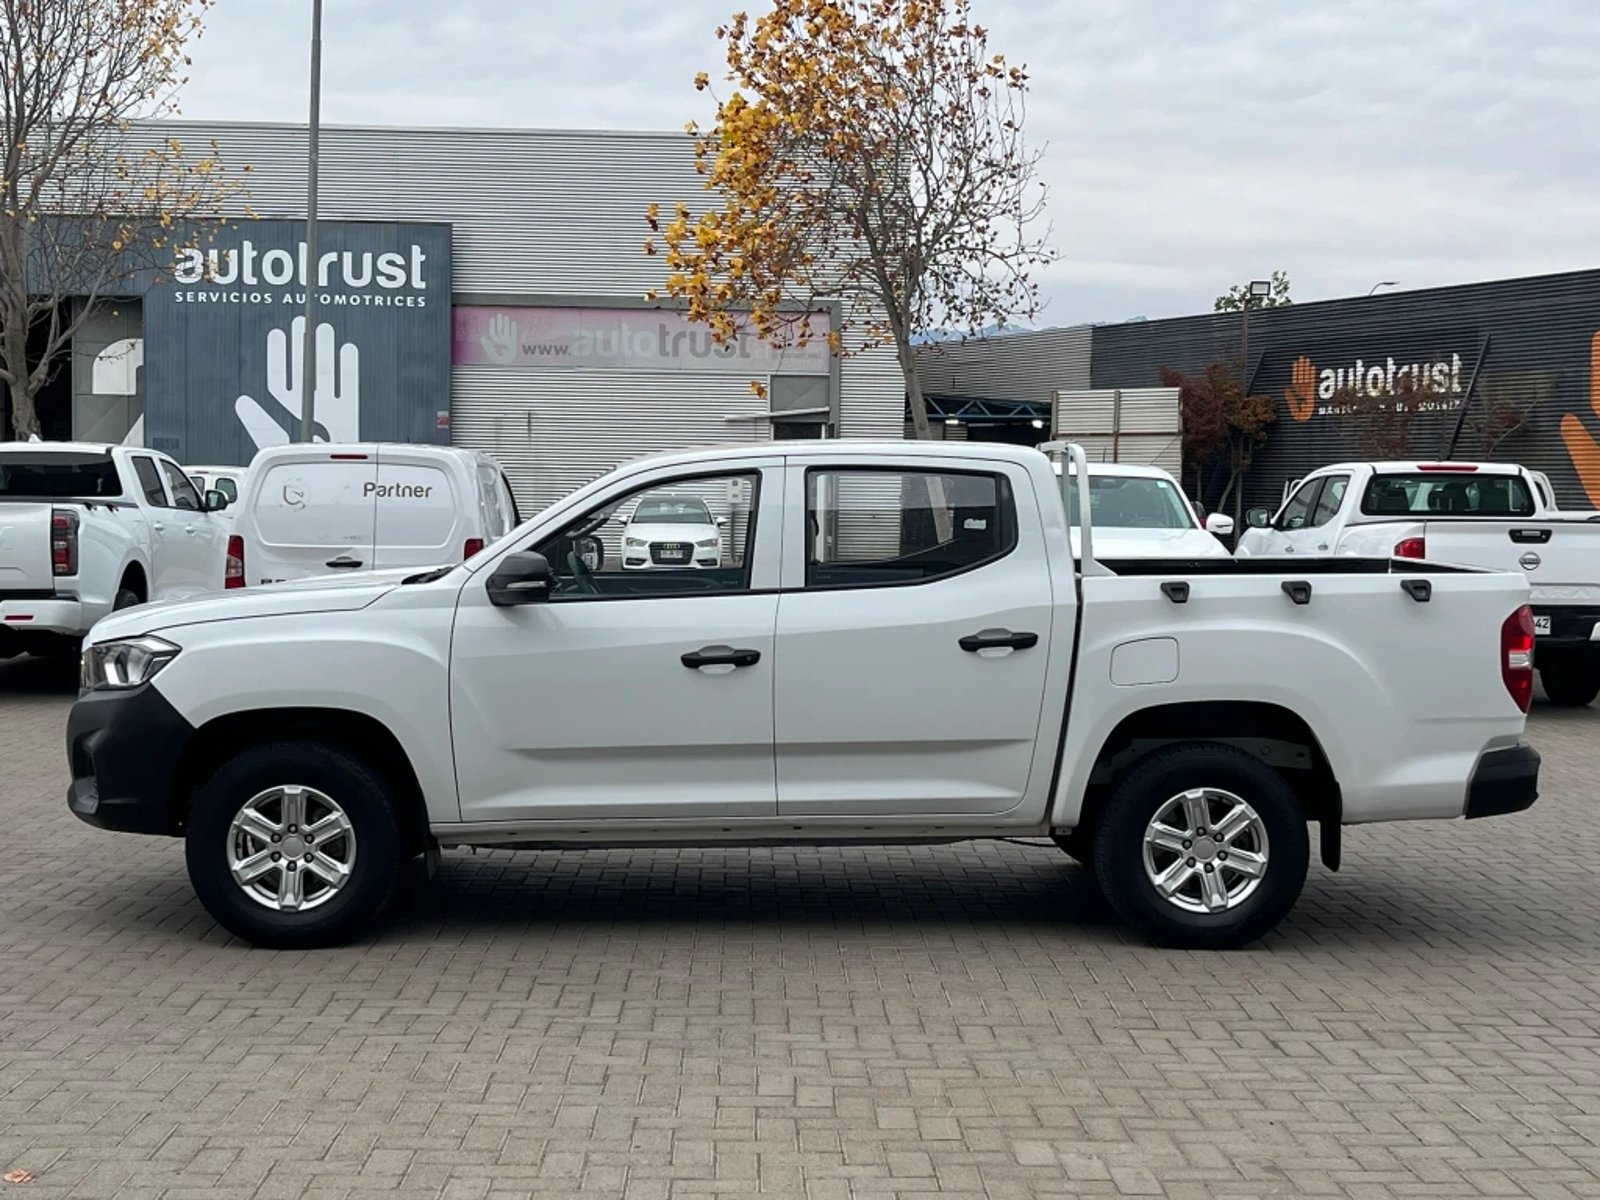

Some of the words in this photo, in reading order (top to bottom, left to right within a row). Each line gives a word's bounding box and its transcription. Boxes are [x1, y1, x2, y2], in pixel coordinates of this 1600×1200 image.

[174, 240, 426, 289] autotrust
[174, 291, 273, 303] SERVICIOS
[282, 293, 426, 307] AUOMOTRICES
[363, 482, 433, 498] Partner
